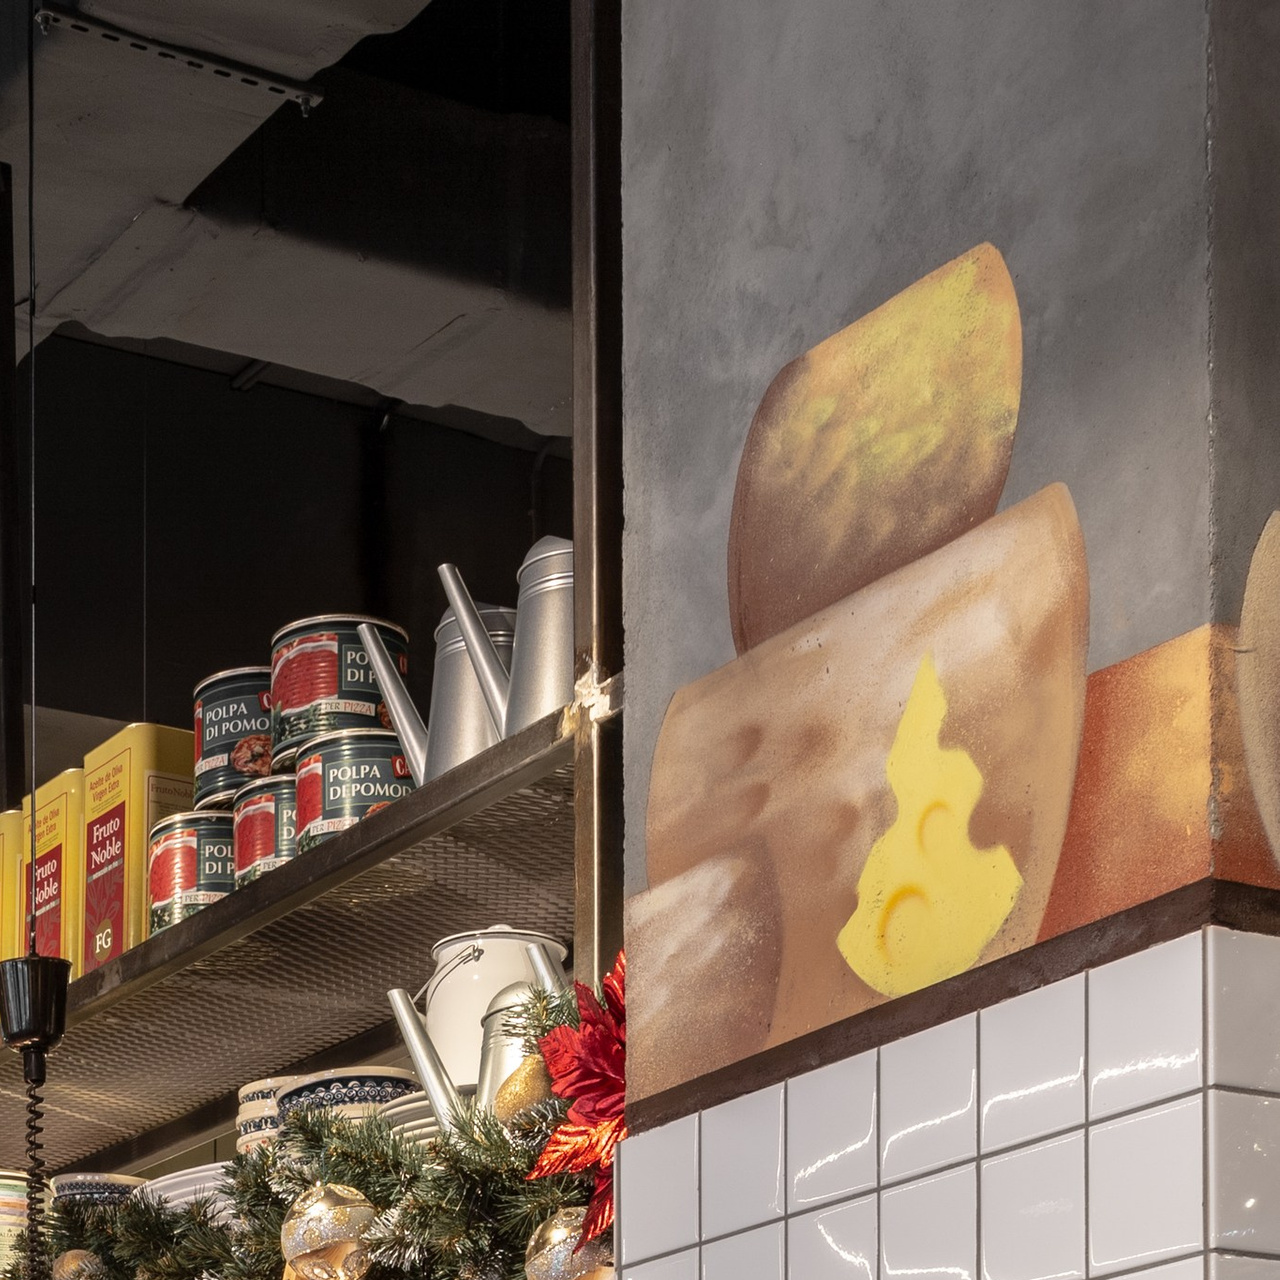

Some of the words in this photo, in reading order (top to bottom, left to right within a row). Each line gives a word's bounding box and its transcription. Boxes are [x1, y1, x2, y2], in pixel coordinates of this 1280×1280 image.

[347, 669, 363, 683] DI
[206, 702, 248, 725] POLPA
[324, 702, 340, 710] PER
[343, 702, 372, 715] PIZZA
[206, 726, 219, 741] DI
[222, 718, 269, 736] POMO
[89, 776, 104, 791] Aceite
[105, 772, 111, 782] de
[112, 764, 123, 778] Oliva
[329, 764, 381, 783] POLPA
[92, 787, 107, 802] Virgen
[109, 779, 120, 793] Extra
[329, 785, 347, 801] DI
[93, 817, 120, 845] Fruto
[312, 824, 324, 834] PER
[91, 840, 121, 869] Noble
[205, 861, 222, 874] DI
[185, 893, 198, 902] PER
[95, 928, 111, 953] FG
